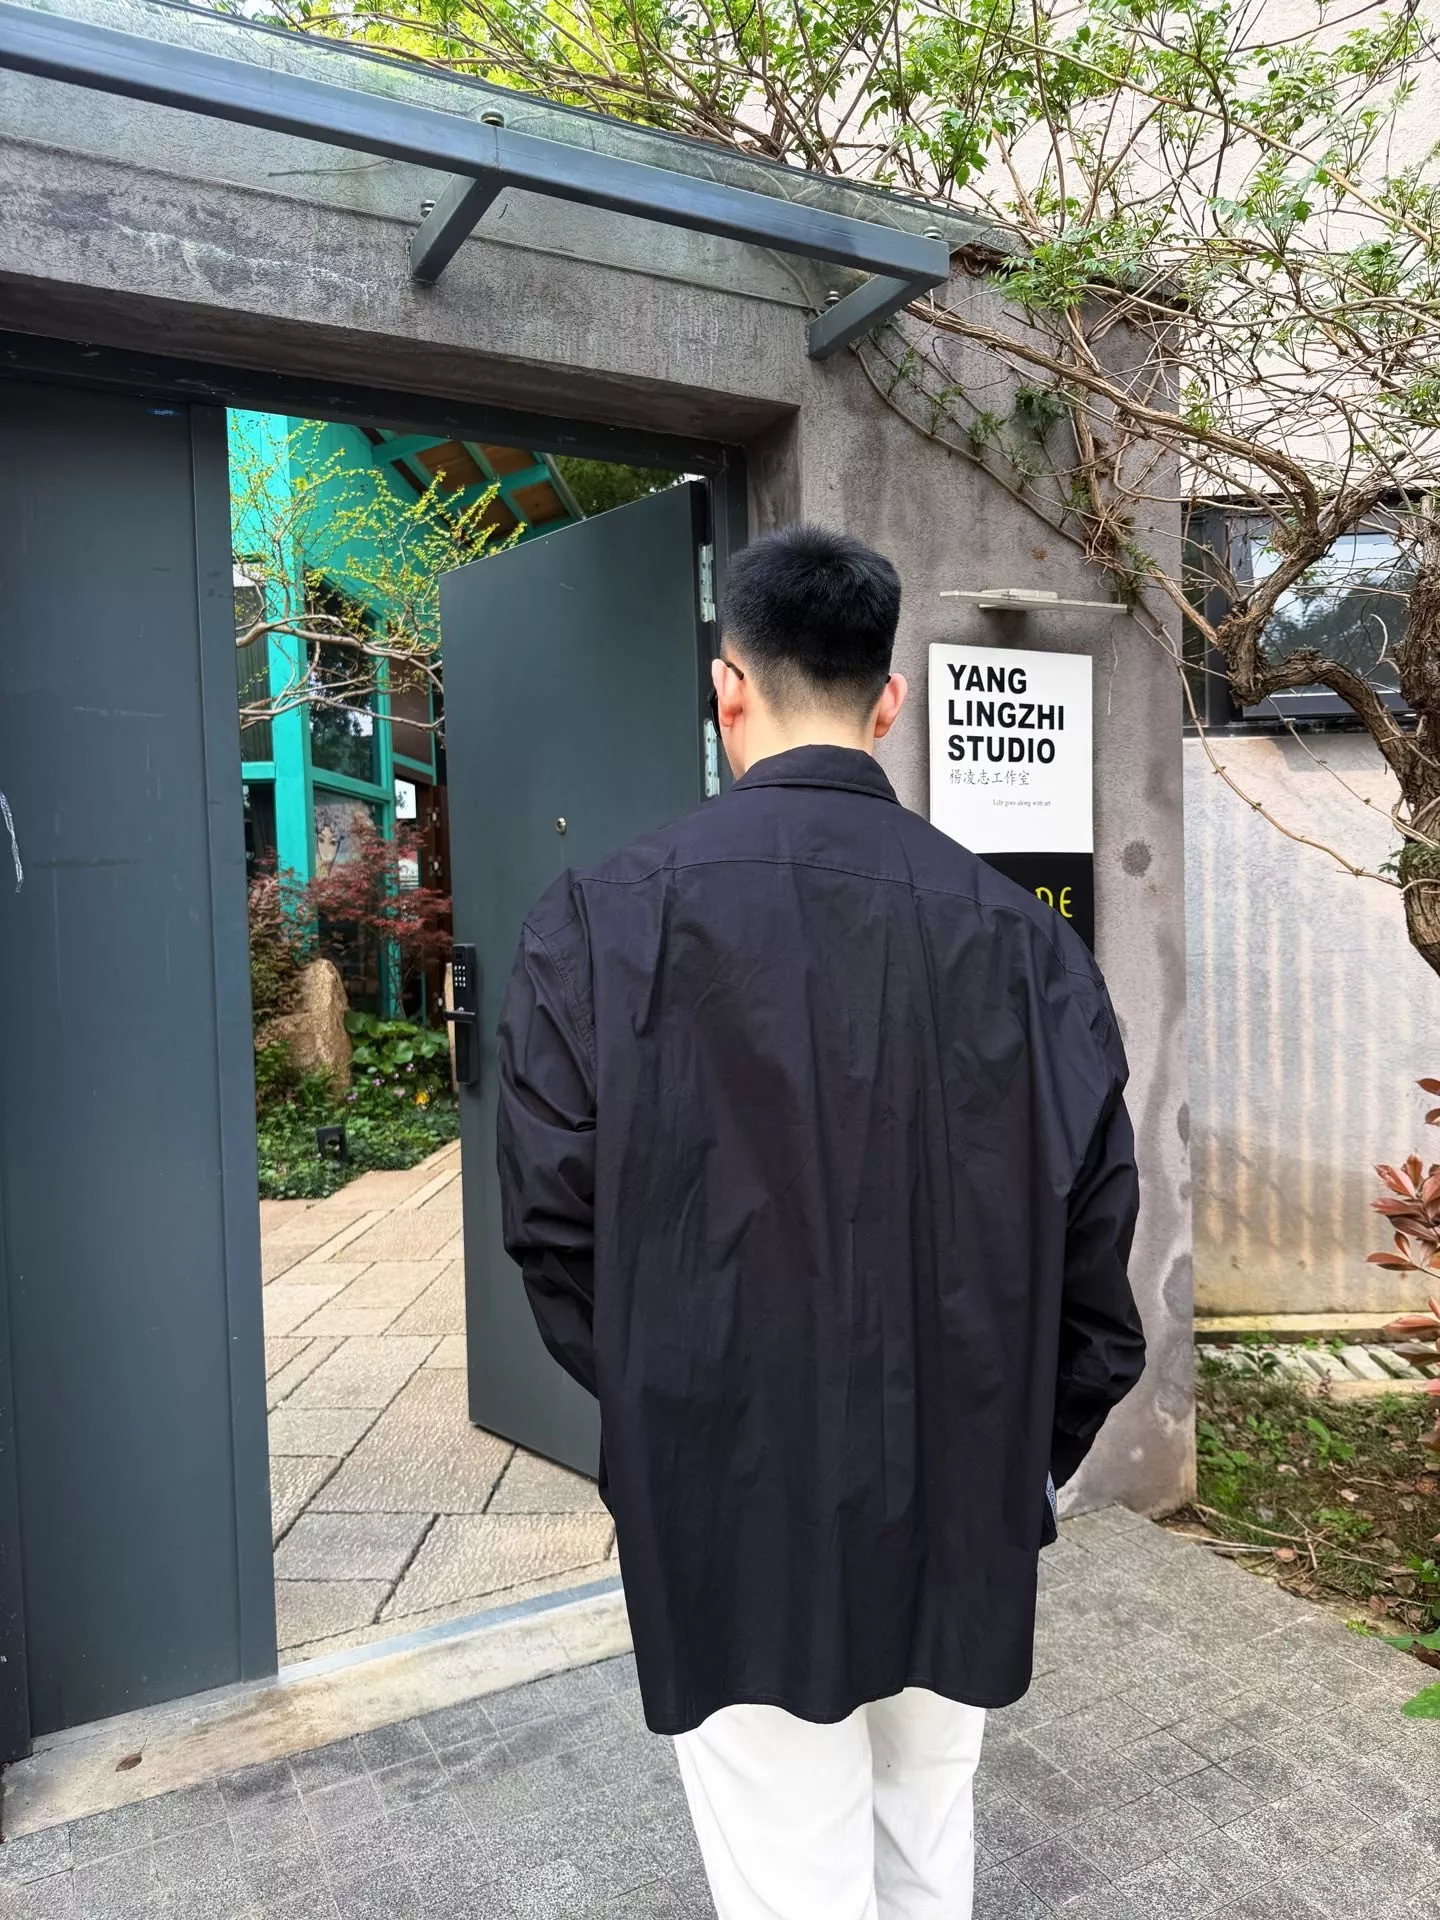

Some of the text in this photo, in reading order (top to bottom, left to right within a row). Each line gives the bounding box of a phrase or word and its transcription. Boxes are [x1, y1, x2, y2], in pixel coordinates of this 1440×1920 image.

[947, 663, 1027, 694] YANG
[948, 699, 1064, 730] LINGZHI
[948, 734, 1056, 764] STUDIO
[1005, 800, 1016, 808] goes
[1017, 799, 1031, 808] along
[1032, 799, 1043, 807] with
